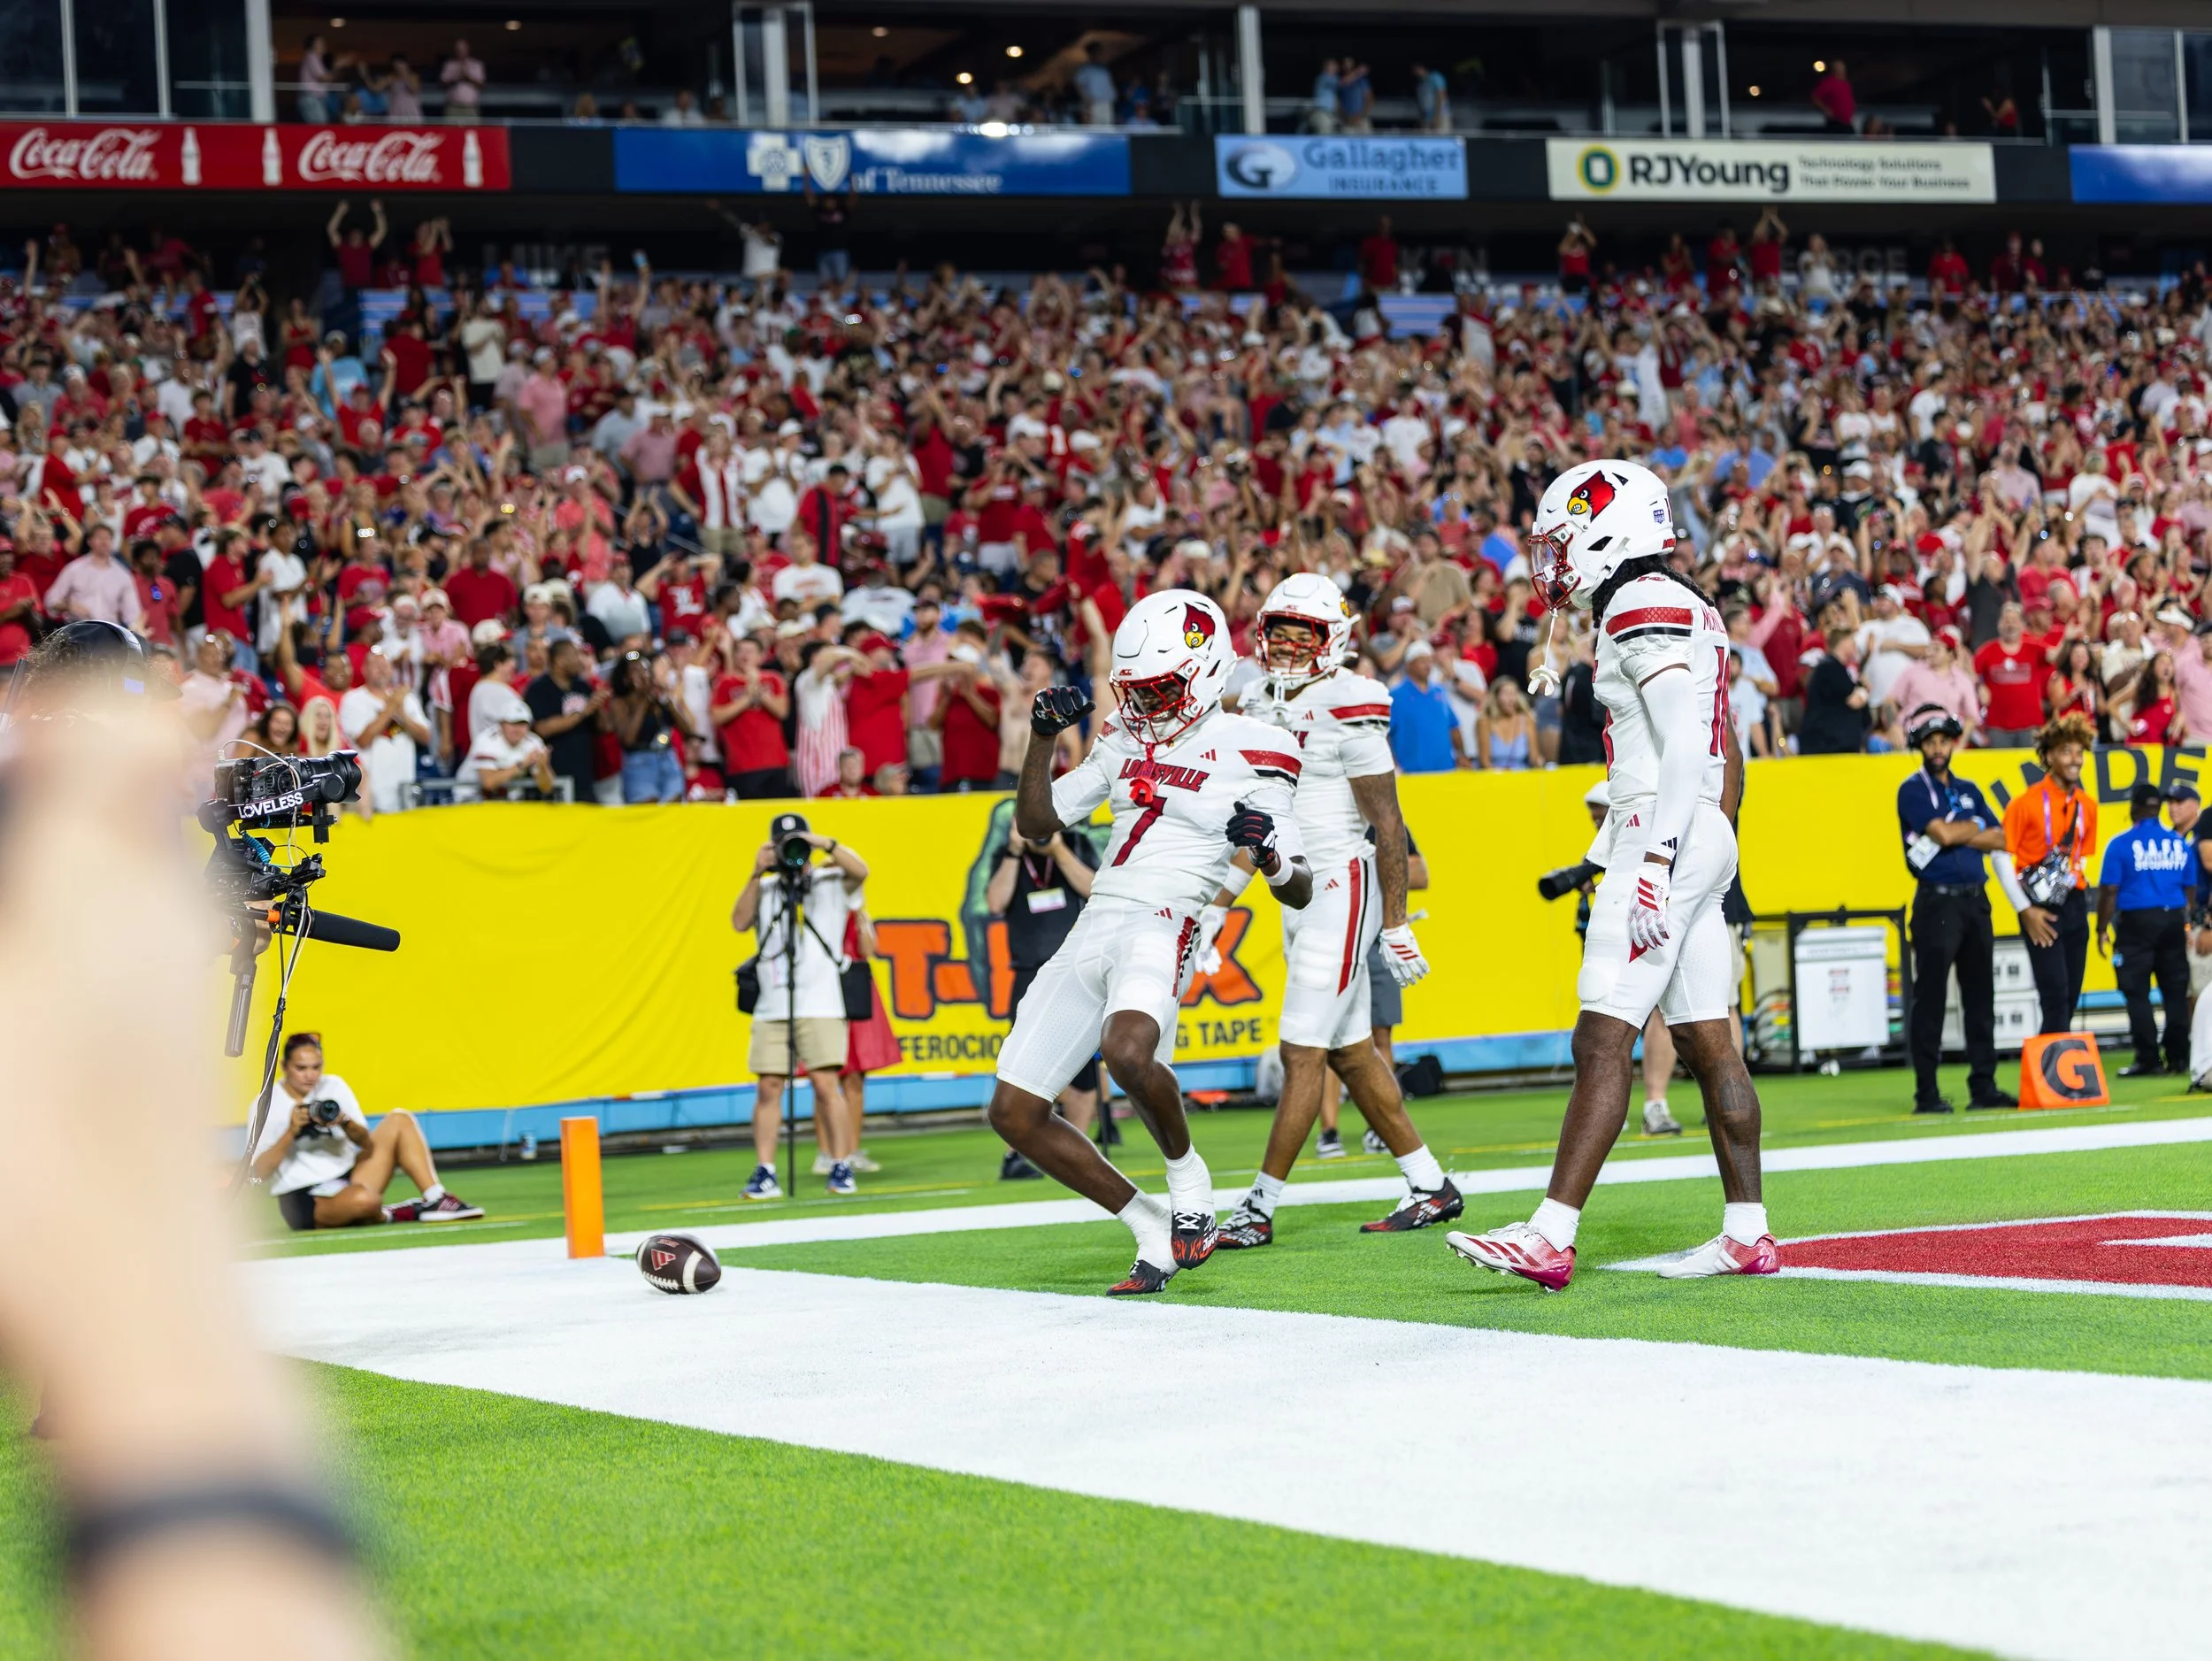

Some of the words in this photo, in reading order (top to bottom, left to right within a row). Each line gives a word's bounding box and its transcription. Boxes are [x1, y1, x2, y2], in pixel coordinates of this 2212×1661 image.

[9, 127, 162, 181] Coca-Cola
[297, 130, 444, 183] Coca-Cola
[1302, 139, 1458, 175] Gallagher
[1798, 155, 1874, 172] Technology
[1878, 157, 1941, 170] Solutions
[853, 166, 877, 192] of
[886, 167, 1002, 192] Tennessee
[1329, 178, 1437, 192] INSURANCE
[1628, 155, 1790, 194] RJYoung
[1911, 177, 1971, 190] Business
[1118, 758, 1210, 793] LOSVILLE
[238, 792, 303, 819] LOVELESS
[1110, 792, 1168, 867] 7
[1198, 1018, 1263, 1047] TAPE
[2040, 1039, 2102, 1099] G
